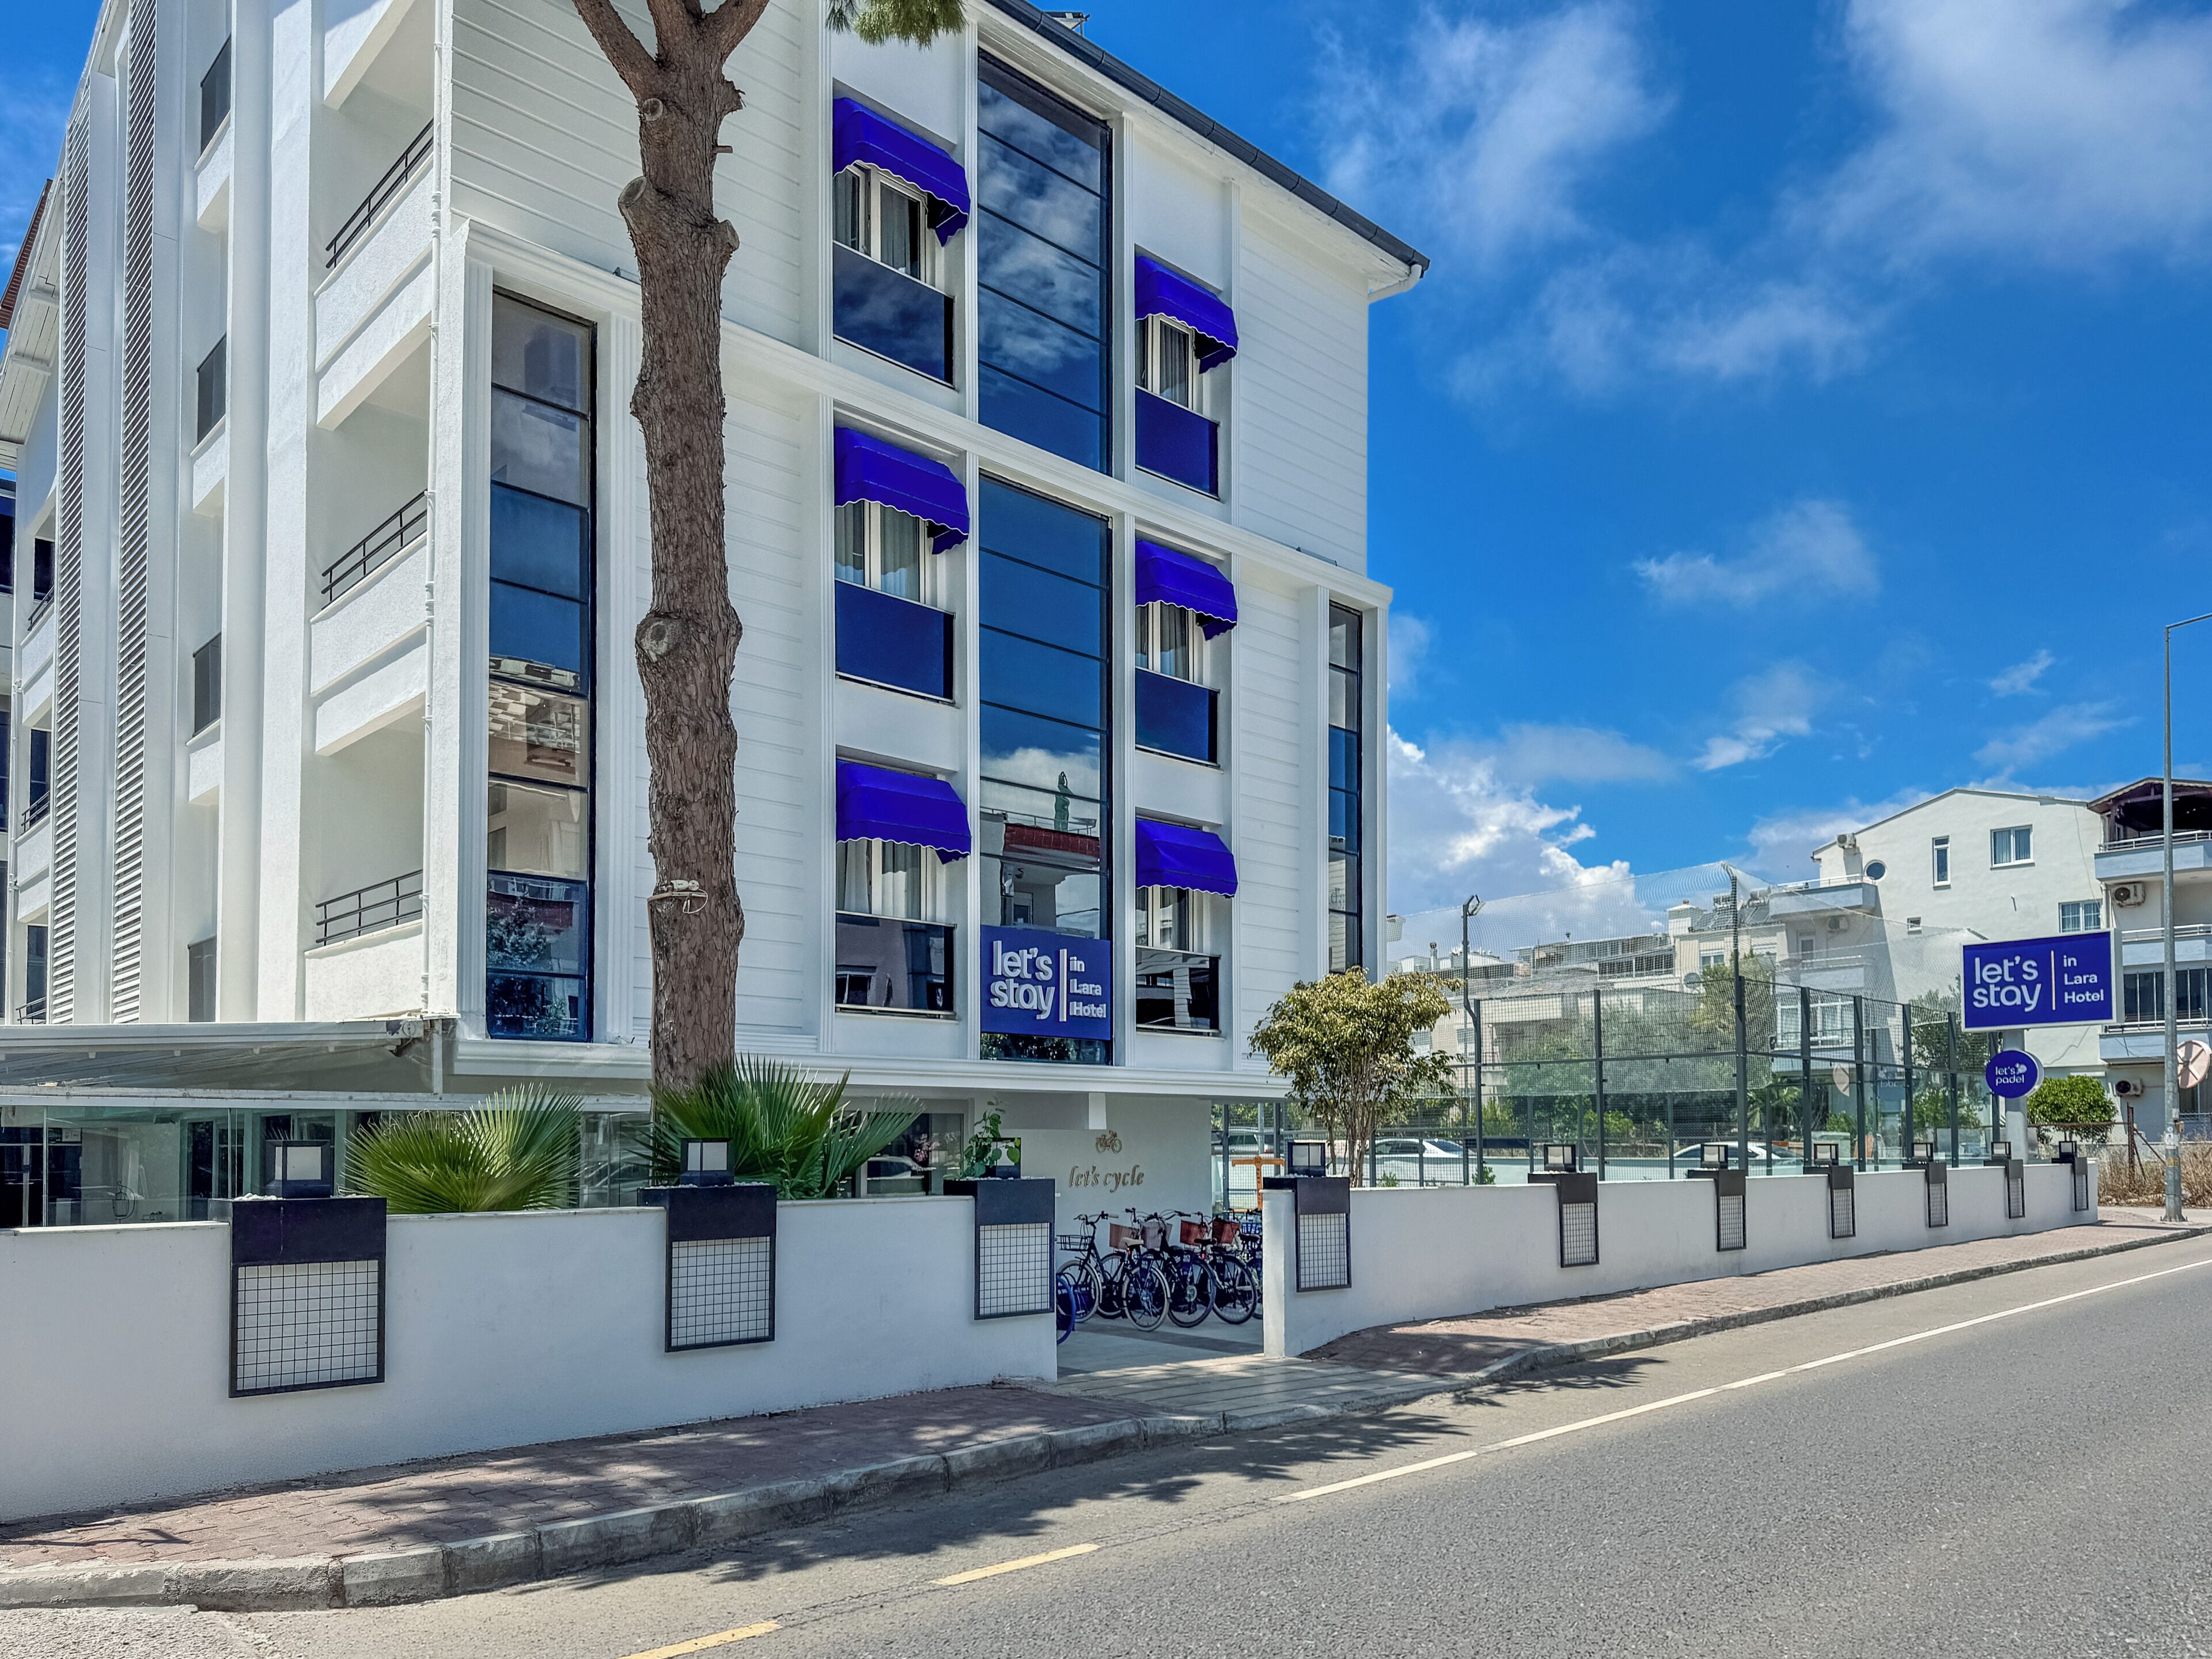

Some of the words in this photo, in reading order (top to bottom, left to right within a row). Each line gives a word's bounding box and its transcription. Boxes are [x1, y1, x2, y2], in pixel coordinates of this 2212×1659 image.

[993, 940, 1053, 980] let's
[1069, 956, 1085, 972] in
[2063, 955, 2077, 967] in
[1975, 955, 2039, 984] let's
[1069, 979, 1102, 996] Lara
[2064, 973, 2098, 986] Lara
[990, 979, 1055, 1020] stay
[1973, 983, 2041, 1012] stay
[2064, 988, 2104, 1003] Hotel
[1069, 1001, 1107, 1018] Hotel
[1995, 1066, 2016, 1075] let's
[1995, 1074, 2025, 1086] padel
[1069, 1164, 1100, 1188] let's
[1103, 1164, 1144, 1194] cycle
